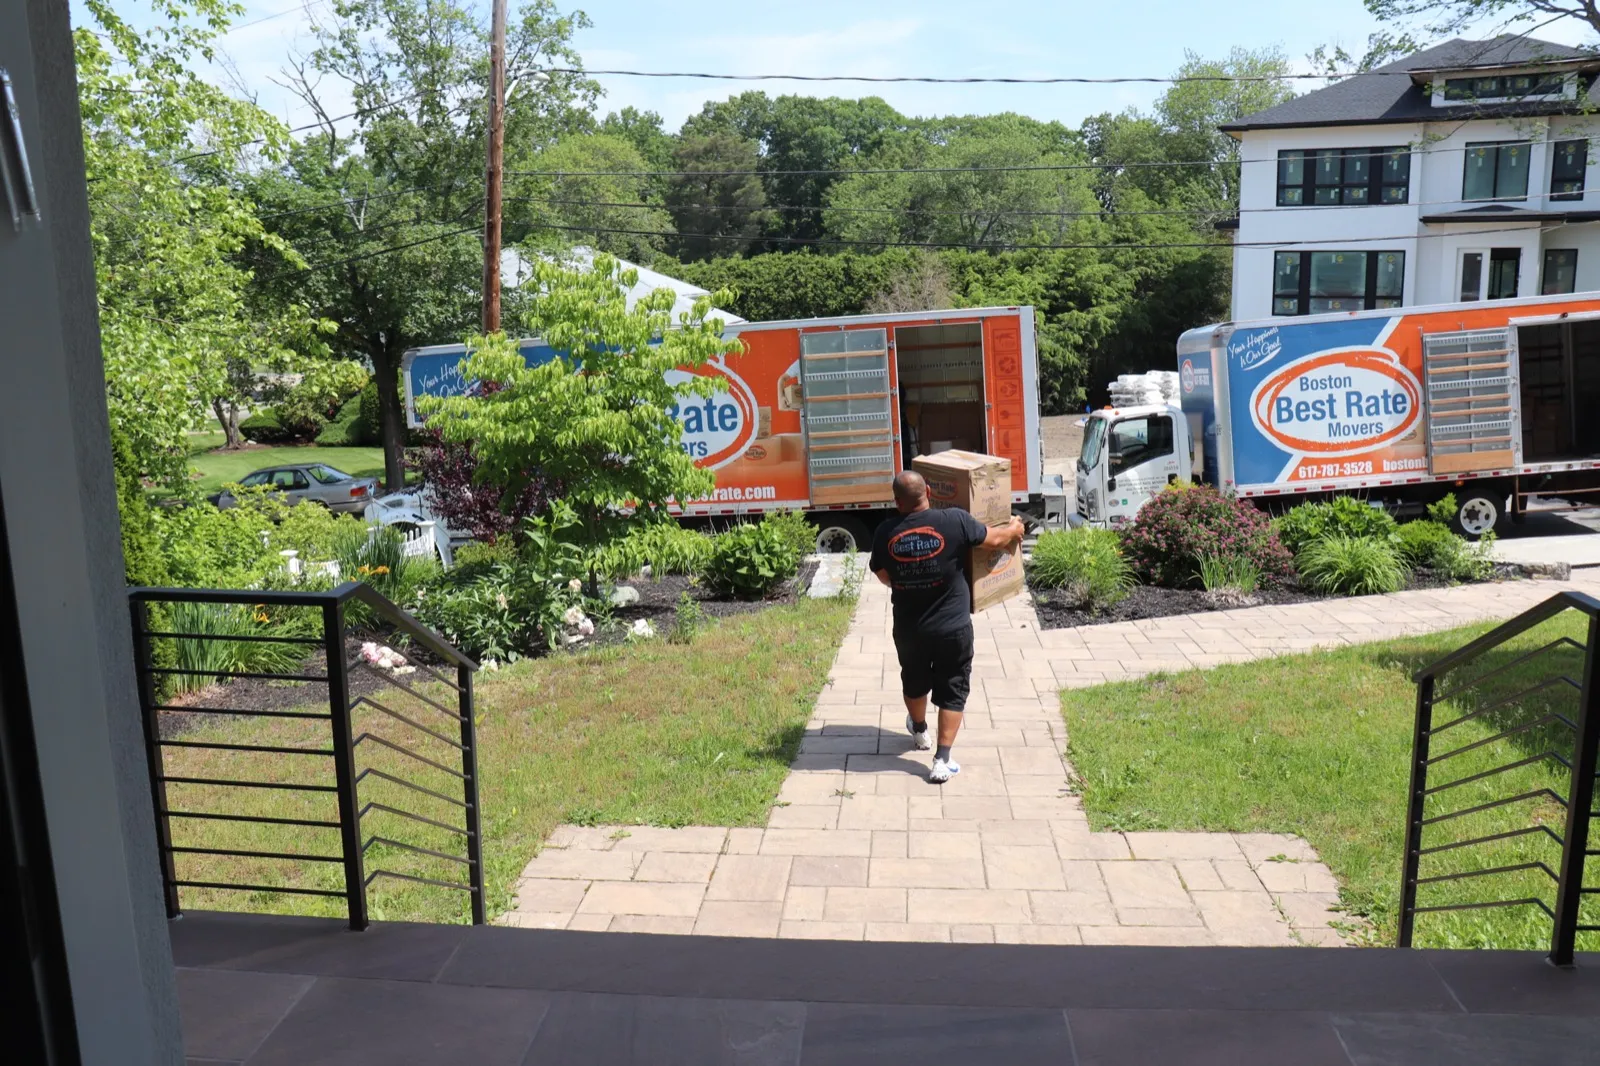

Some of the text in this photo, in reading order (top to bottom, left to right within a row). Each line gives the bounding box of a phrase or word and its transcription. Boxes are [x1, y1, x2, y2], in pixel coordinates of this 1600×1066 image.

[1228, 326, 1279, 359] Your Happiness
[1246, 350, 1261, 364] Our
[1261, 336, 1282, 356] Goal
[1299, 374, 1352, 392] Boston
[1275, 389, 1407, 424] Best Rate
[1328, 421, 1384, 438] Movers
[680, 440, 708, 457] ers
[1298, 461, 1373, 479] 617-787-3528
[916, 539, 940, 550] Rate
